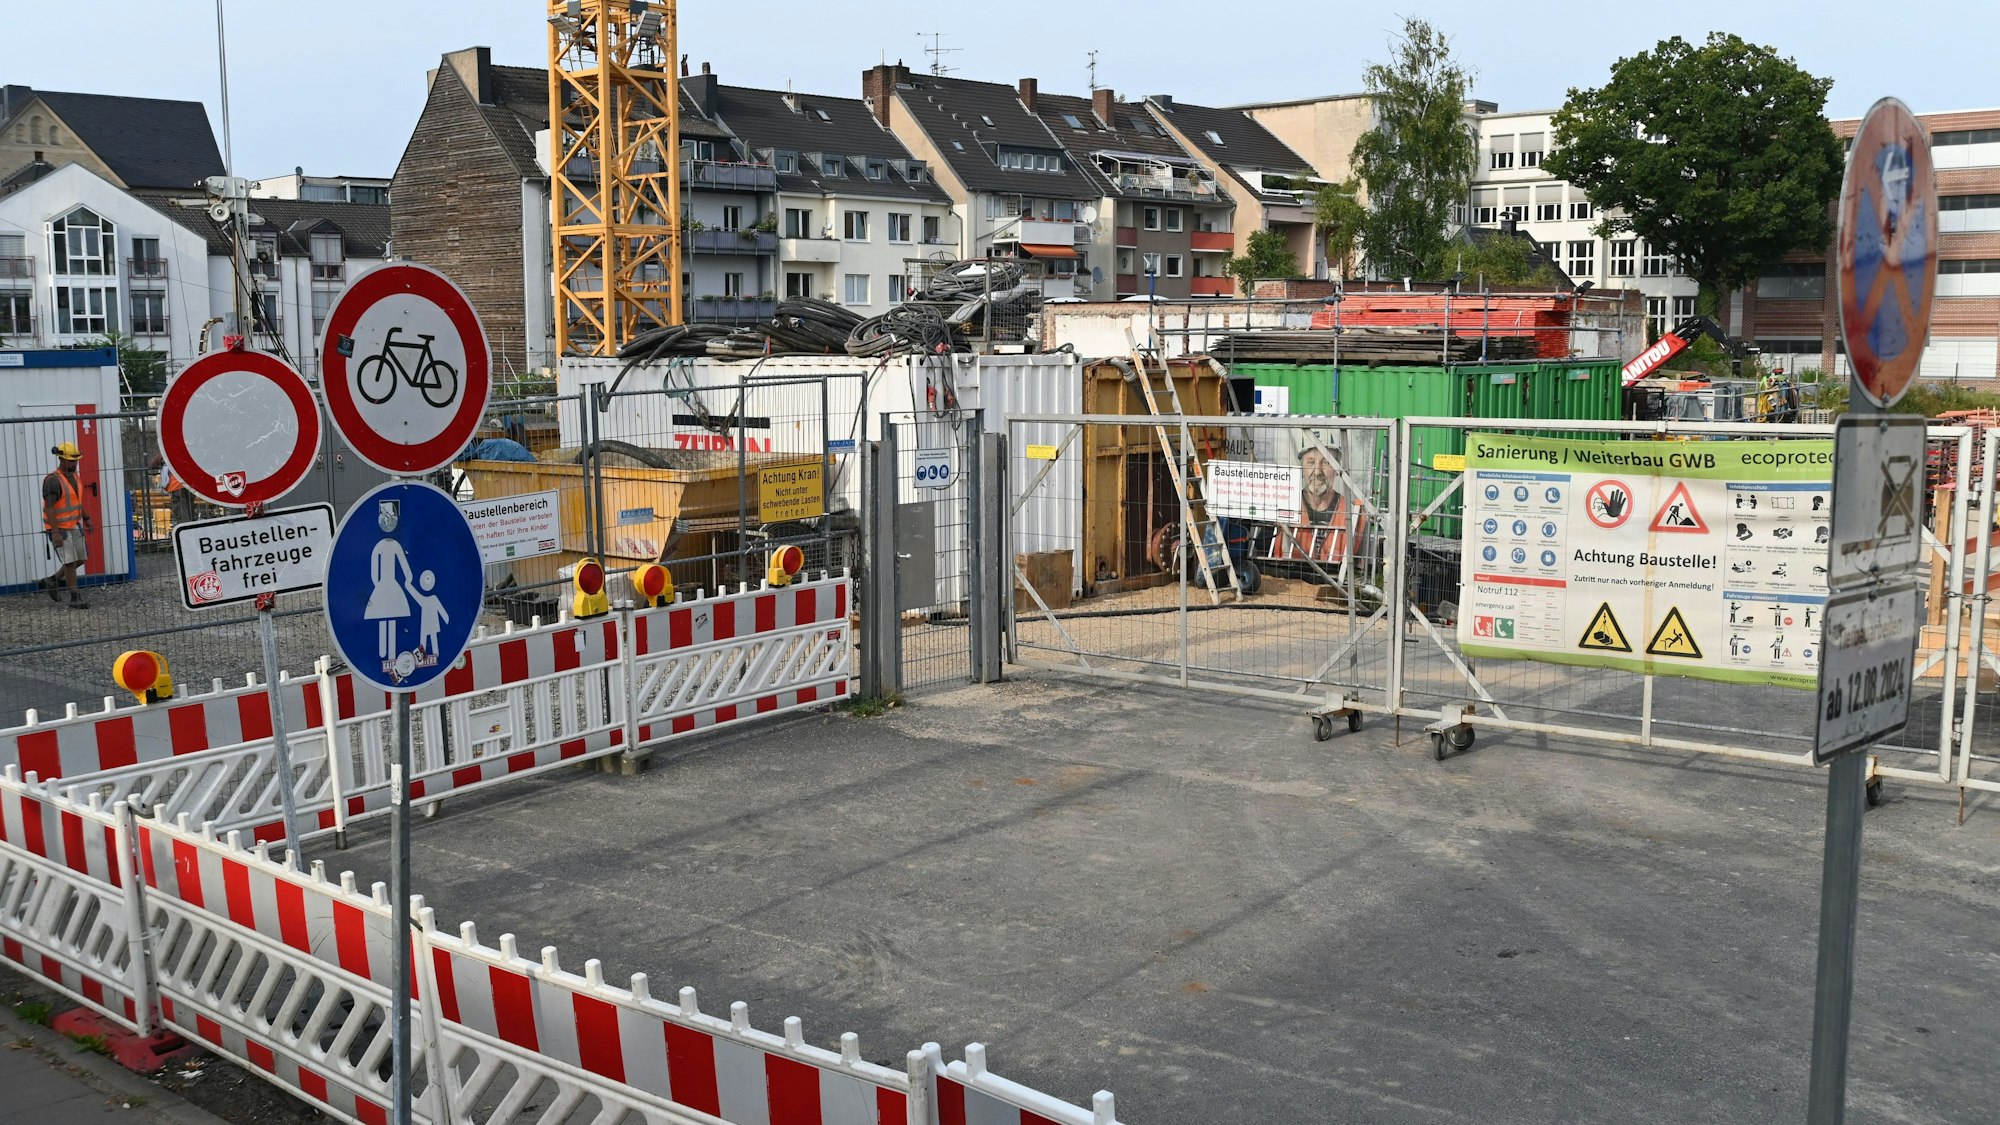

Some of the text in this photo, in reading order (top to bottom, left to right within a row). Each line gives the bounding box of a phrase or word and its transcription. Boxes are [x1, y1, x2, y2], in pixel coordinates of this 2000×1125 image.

[1621, 339, 1670, 386] ANITOU
[1477, 444, 1716, 468] Sanierung / Weiterbau GWB
[762, 467, 820, 485] Achtung Kran!
[1214, 466, 1291, 481] Baustellenbereich
[775, 486, 808, 497] Nicht unter
[463, 498, 548, 520] austellenbereich
[762, 495, 820, 509] schwebende Lasten
[488, 520, 498, 528] der
[500, 516, 526, 526] Baustelle
[528, 512, 552, 521] verboten
[199, 525, 318, 554] Baustellen-
[486, 531, 505, 539] haften
[506, 528, 515, 536] für
[530, 523, 549, 532] Kinder
[211, 545, 312, 573] fahrzeuge
[1574, 549, 1717, 569] Achtung Baustelle!
[243, 567, 278, 588] frei
[1574, 574, 1596, 583] Zutritt
[1611, 577, 1628, 585] nach
[1629, 578, 1667, 589] vorheriger
[1668, 581, 1715, 591] Anmeldung!
[1477, 585, 1518, 596] Notruf 112
[1475, 602, 1504, 610] emergency
[1826, 656, 1905, 721] ab 12.08.2024
